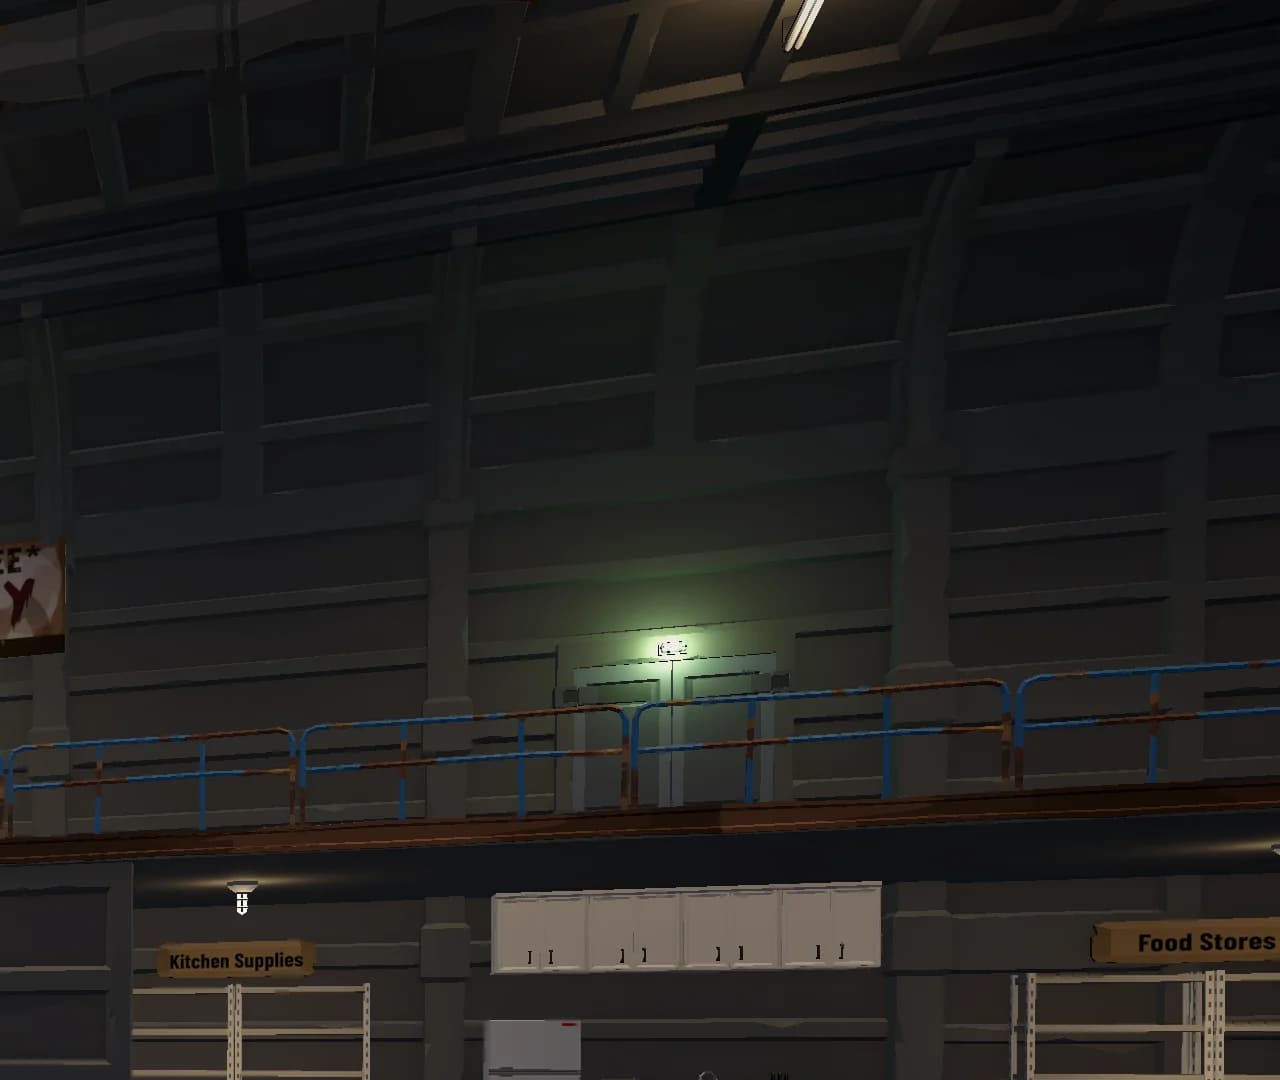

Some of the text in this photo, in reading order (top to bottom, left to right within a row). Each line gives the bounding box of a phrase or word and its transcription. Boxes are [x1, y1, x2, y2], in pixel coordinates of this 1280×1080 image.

[1139, 932, 1276, 952] Food Stores
[170, 952, 303, 971] Kitchen Supplies
